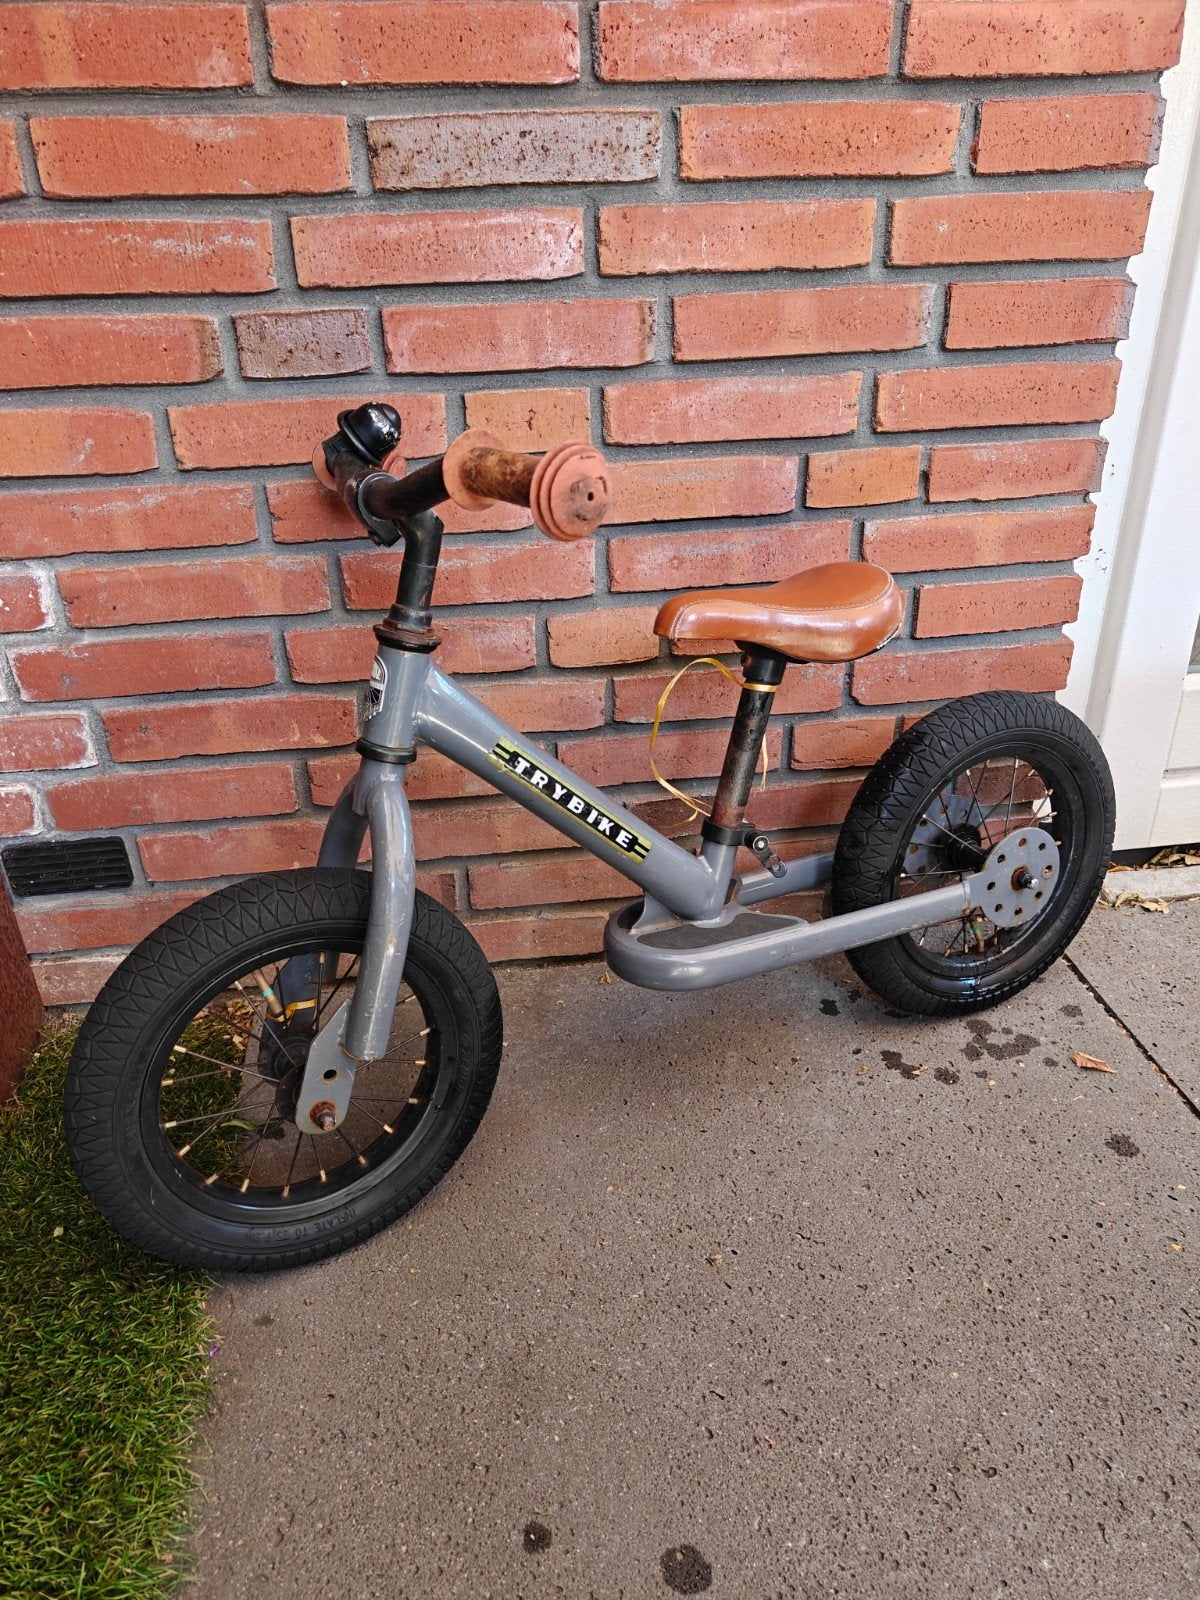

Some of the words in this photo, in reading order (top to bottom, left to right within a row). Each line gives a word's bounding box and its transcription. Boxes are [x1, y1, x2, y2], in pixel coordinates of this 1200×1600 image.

[514, 756, 633, 848] TRYBIKE
[295, 1225, 311, 1240] TO
[314, 1207, 357, 1233] INFLATE
